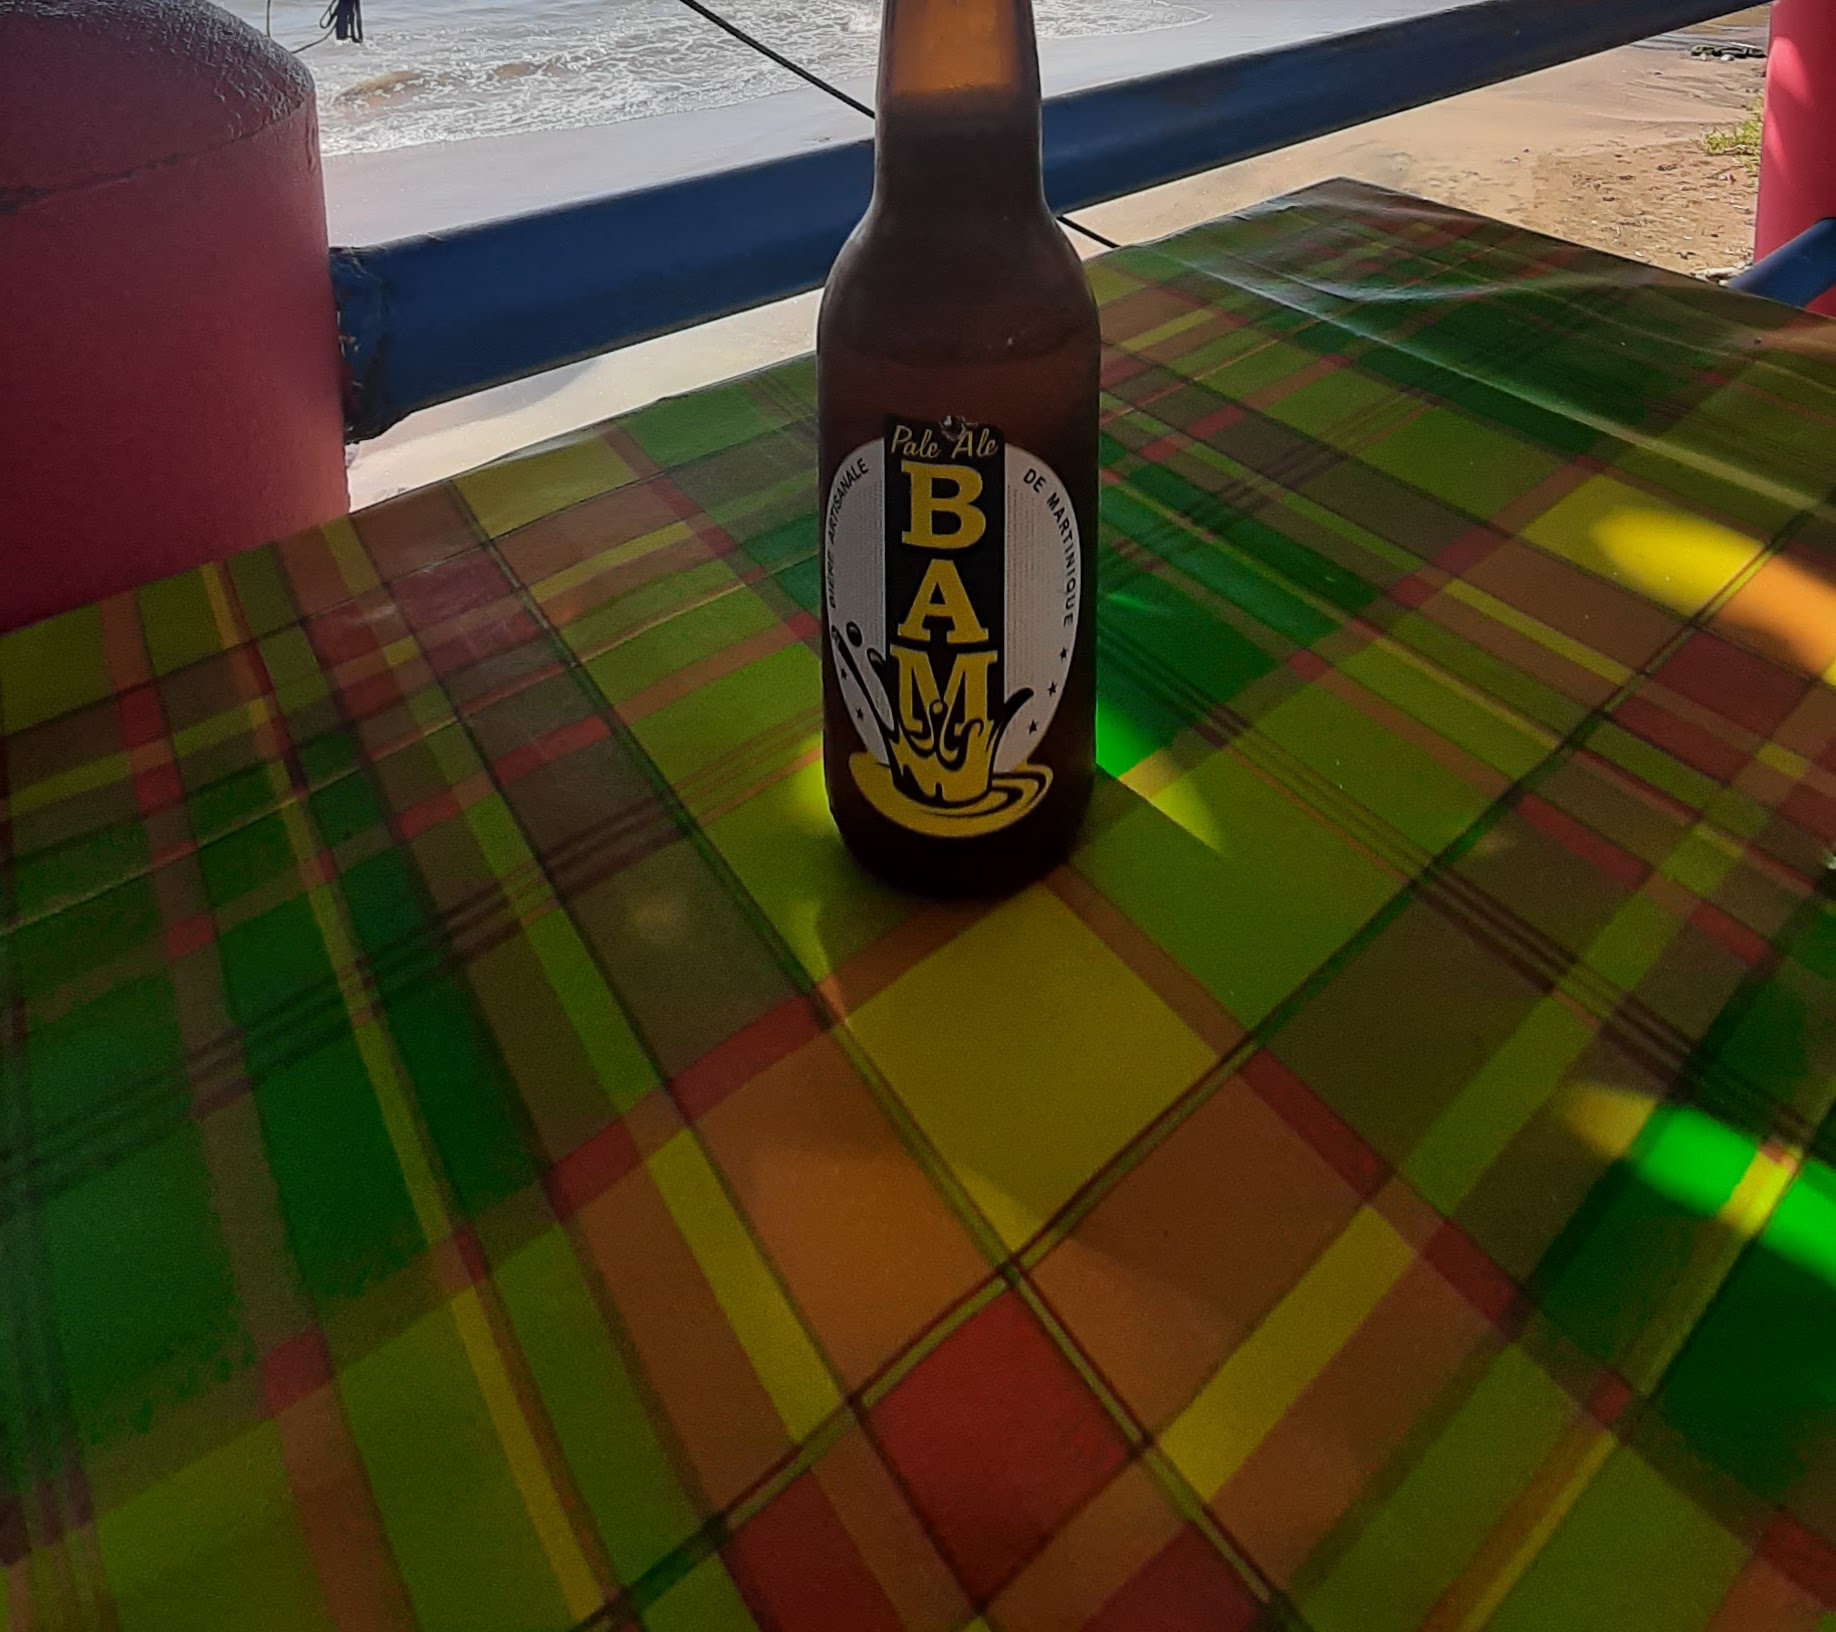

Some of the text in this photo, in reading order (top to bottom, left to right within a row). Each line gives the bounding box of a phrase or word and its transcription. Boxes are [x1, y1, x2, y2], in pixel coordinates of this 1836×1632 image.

[828, 457, 869, 545] ARTISANALE
[891, 424, 999, 459] Pale Ale
[889, 461, 998, 740] BAM
[1023, 469, 1076, 628] DE MARTINIQUE
